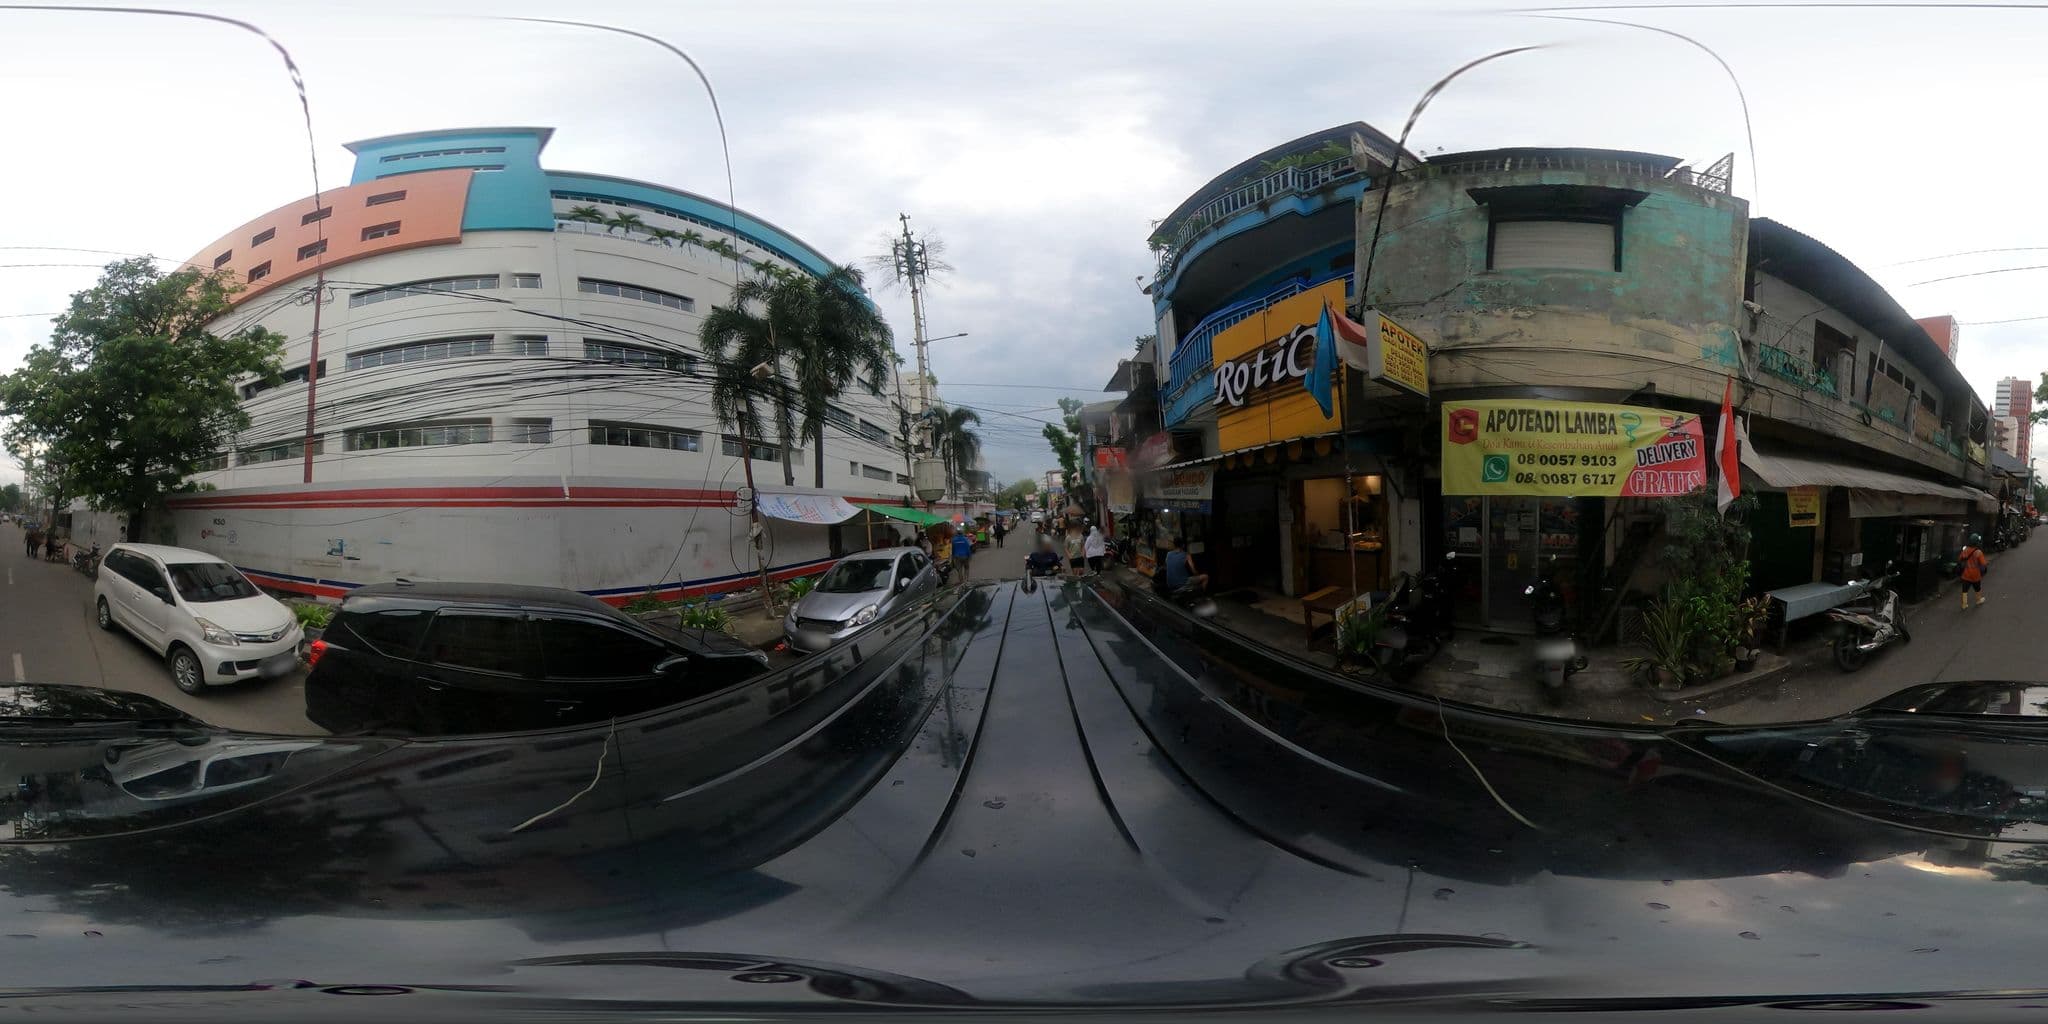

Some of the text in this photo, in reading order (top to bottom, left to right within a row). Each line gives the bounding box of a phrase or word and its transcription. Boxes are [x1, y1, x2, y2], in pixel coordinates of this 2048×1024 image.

[1381, 321, 1424, 357] APOTEK
[1565, 410, 1618, 435] LAMBA
[1517, 453, 1617, 466] 08 0057 9103
[1636, 440, 1697, 467] DELIVERY
[1541, 474, 1577, 485] 0087
[1582, 474, 1616, 485] 6717
[1630, 470, 1702, 495] GRATIS
[213, 518, 226, 526] KSO
